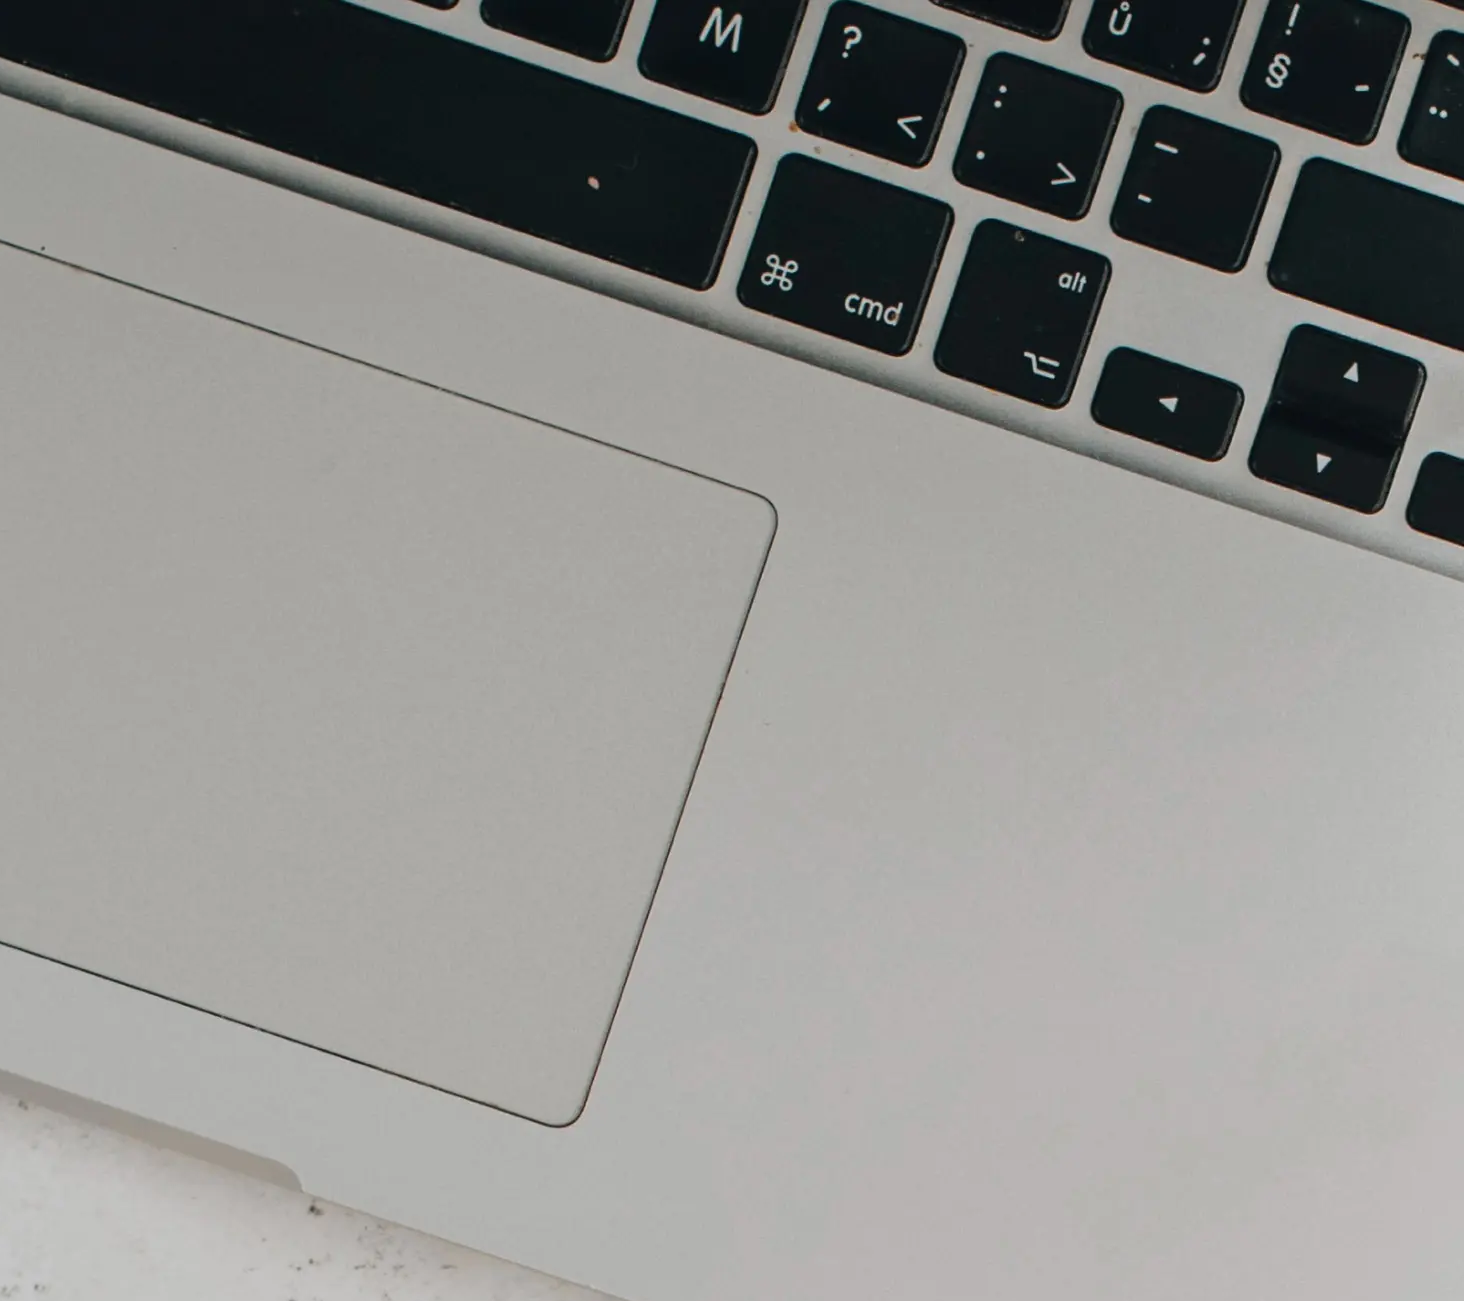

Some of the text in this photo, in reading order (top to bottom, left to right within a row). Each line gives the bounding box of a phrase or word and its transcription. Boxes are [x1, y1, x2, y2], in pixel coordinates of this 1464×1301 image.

[699, 6, 743, 53] M
[843, 25, 863, 58] ?
[1058, 269, 1087, 294] alt
[844, 292, 904, 327] cmd
